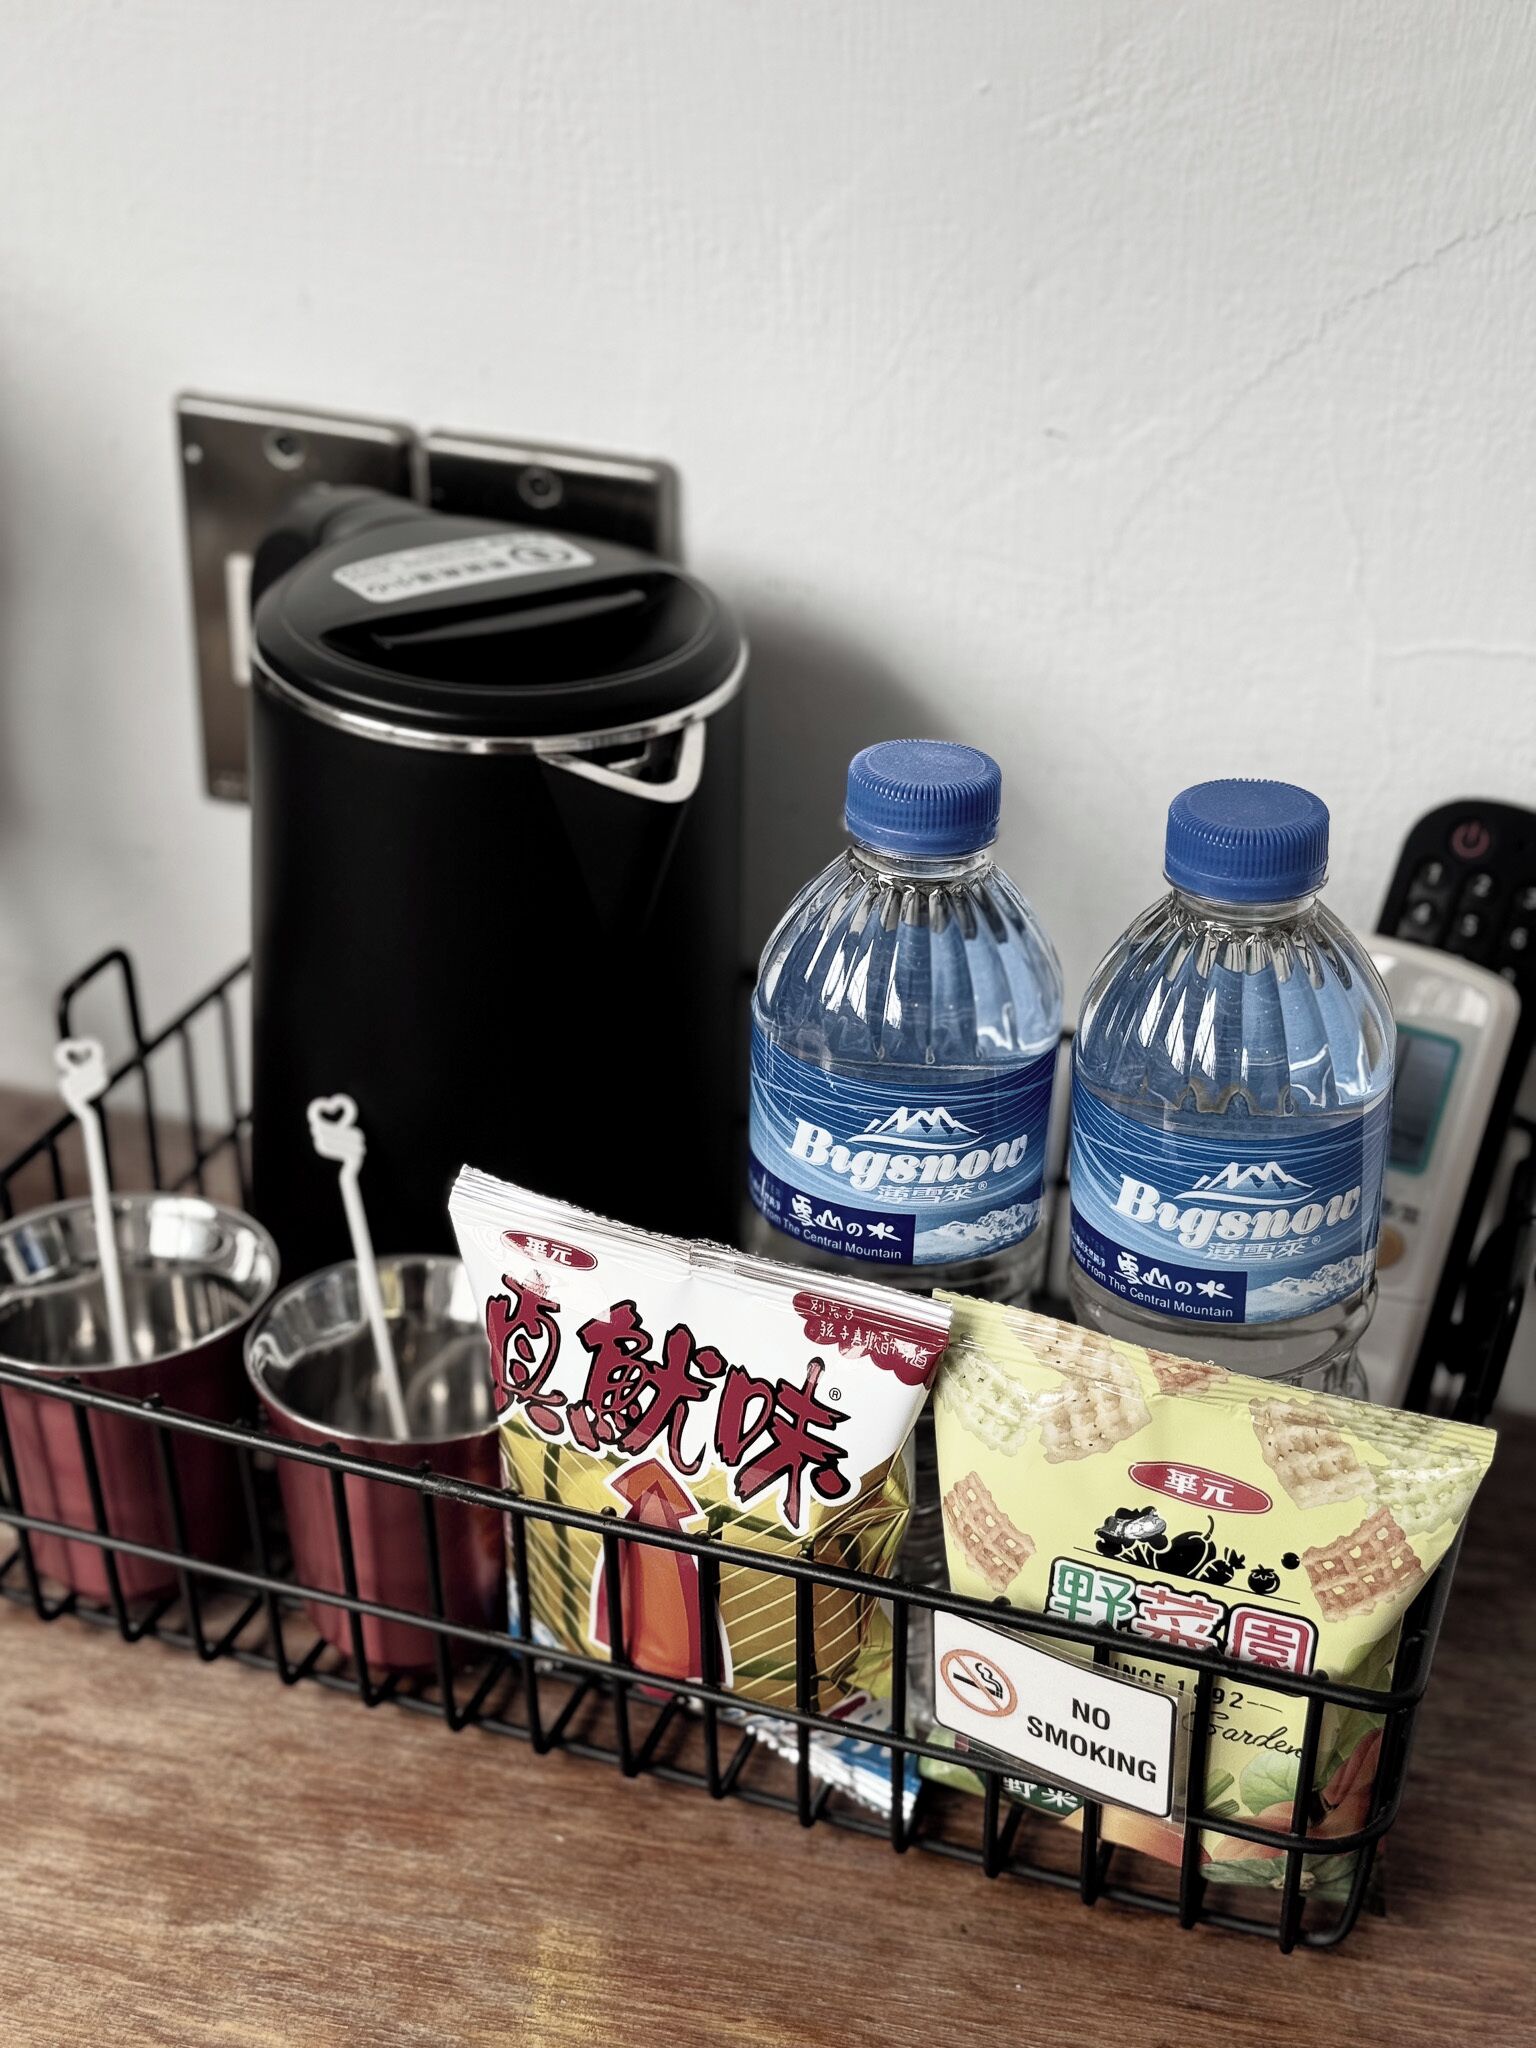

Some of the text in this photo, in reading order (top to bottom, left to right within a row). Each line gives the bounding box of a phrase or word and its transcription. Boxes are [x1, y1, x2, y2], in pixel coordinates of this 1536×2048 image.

[786, 1117, 1028, 1191] Bigsnow
[784, 1217, 801, 1236] The
[803, 1229, 842, 1250] Central
[845, 1241, 902, 1260] Mountain
[1110, 1173, 1362, 1249] Bigsnow
[1086, 1258, 1107, 1282] From
[1109, 1274, 1126, 1294] The
[1129, 1286, 1170, 1309] Central
[1173, 1300, 1233, 1318] Mountain
[1163, 1468, 1235, 1507] 華元
[1053, 1564, 1311, 1676] 野菜園
[1072, 1697, 1111, 1731] NO
[1026, 1715, 1157, 1784] SMOKING
